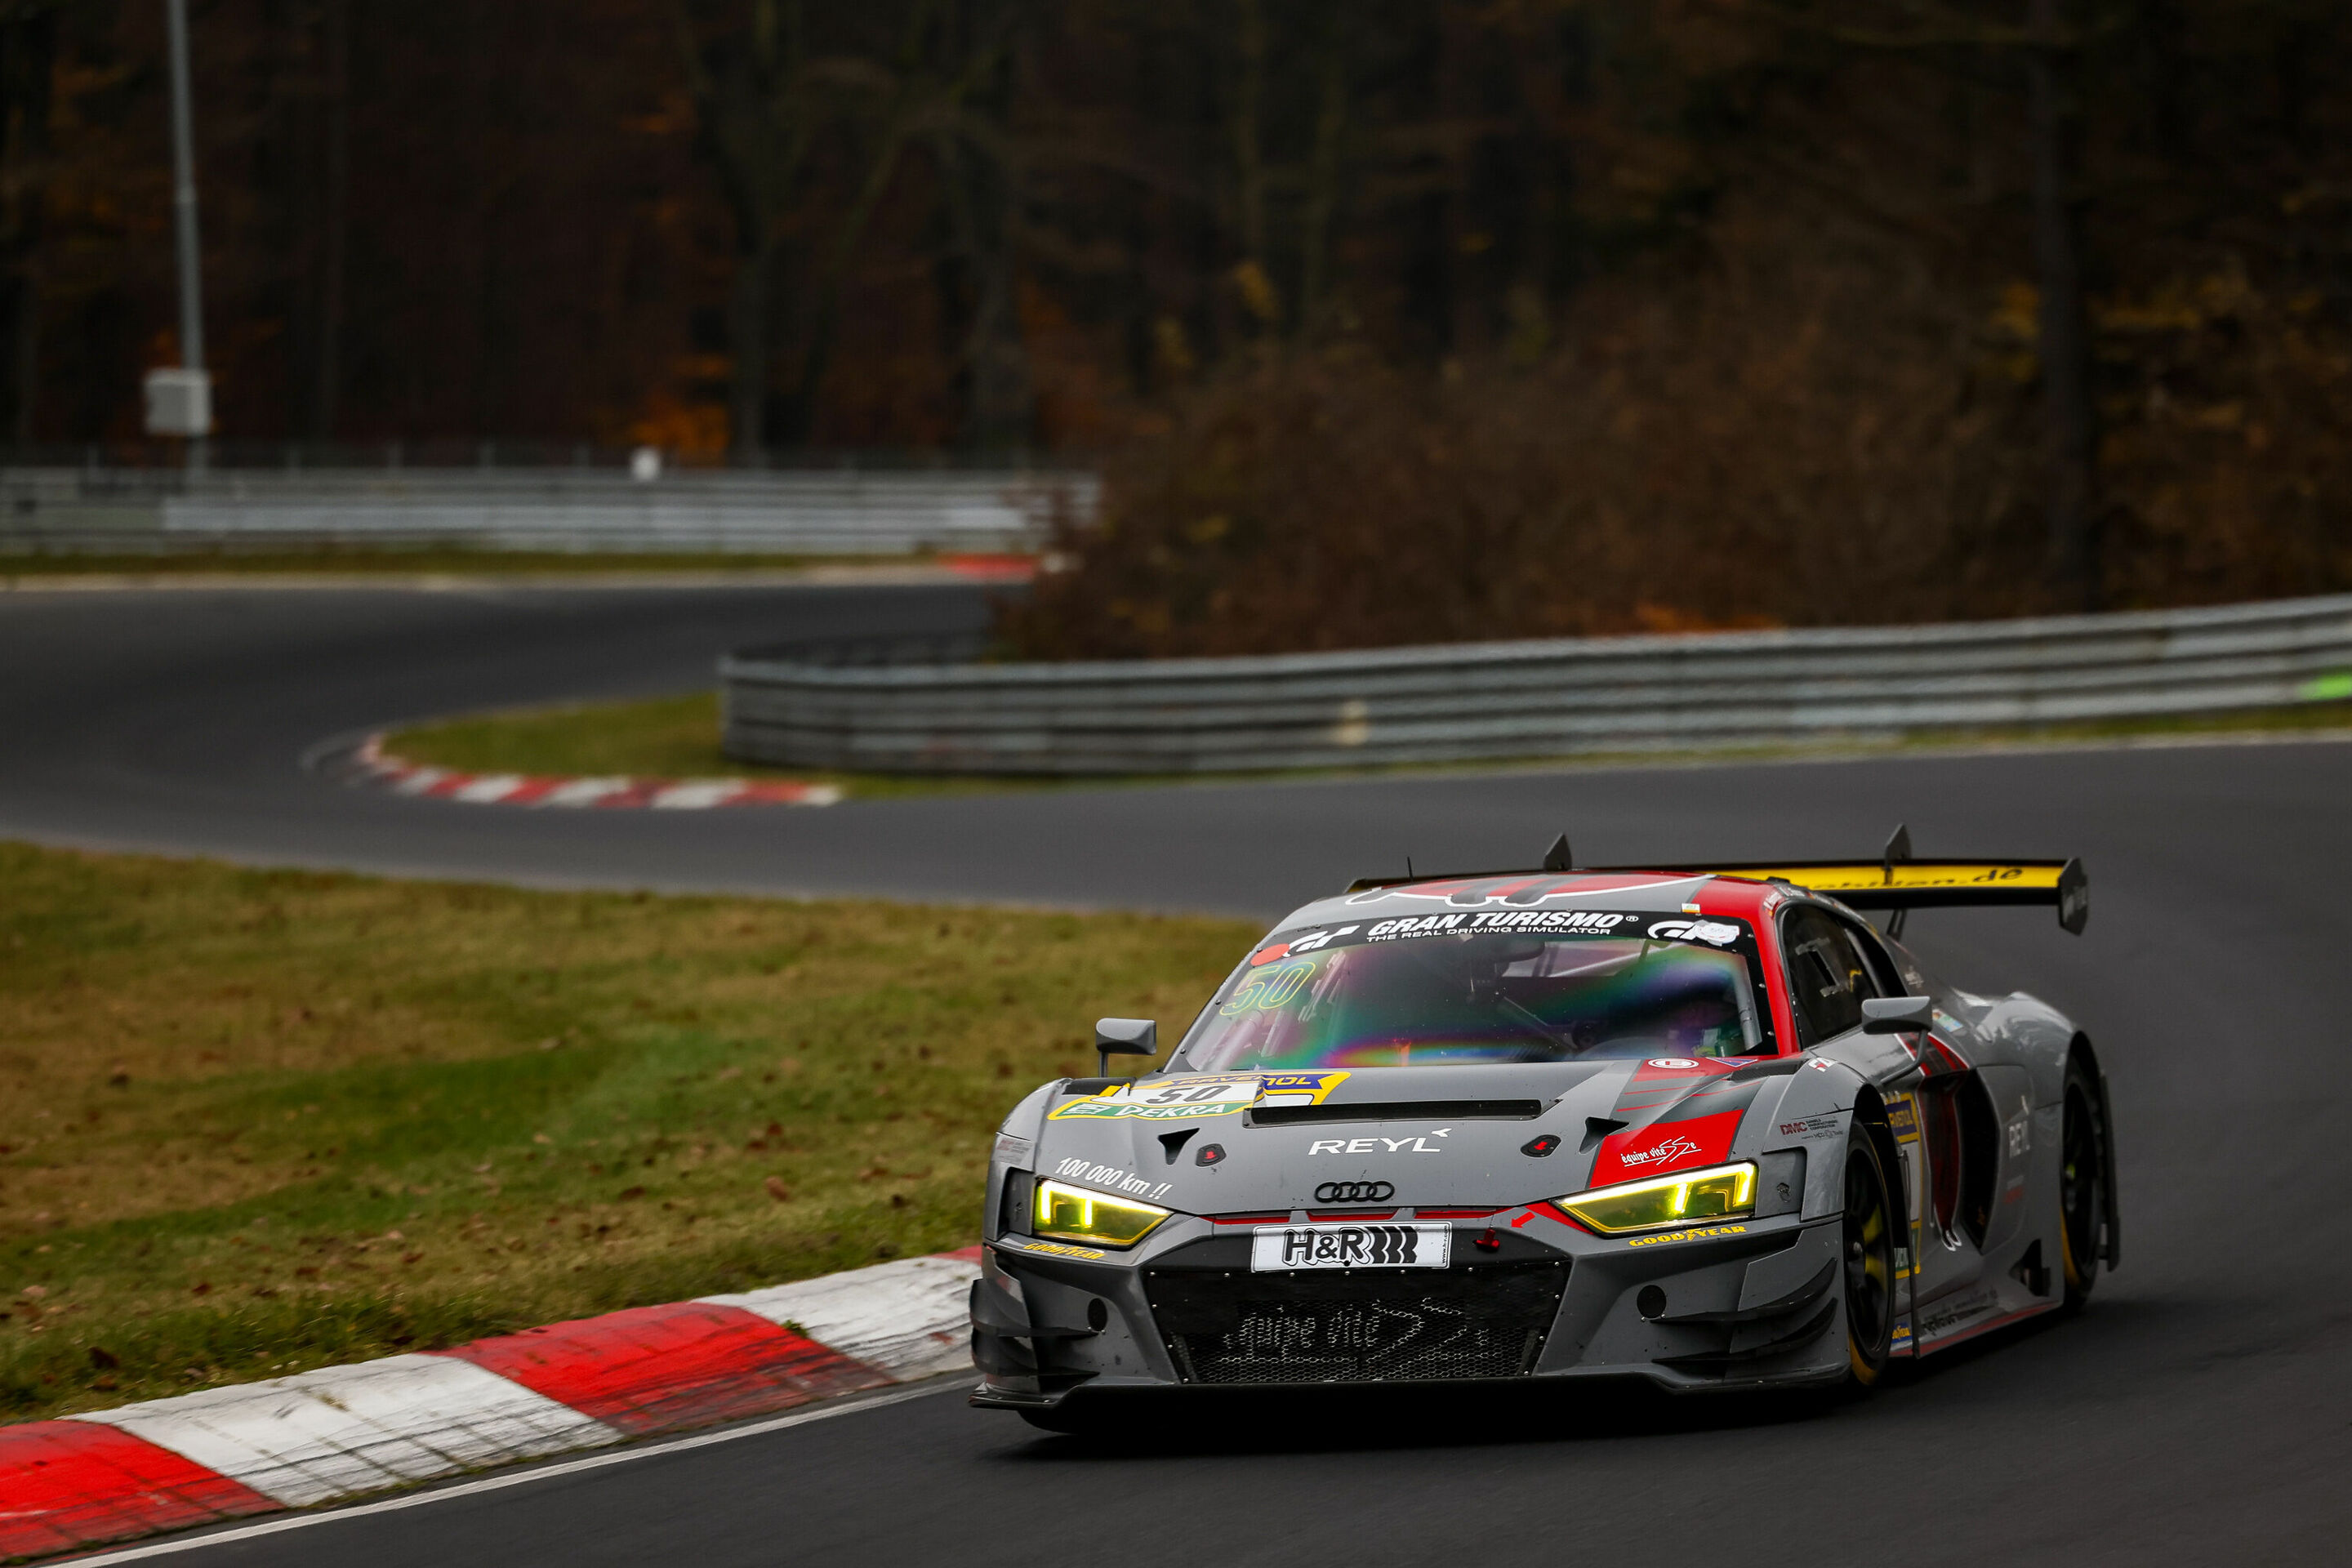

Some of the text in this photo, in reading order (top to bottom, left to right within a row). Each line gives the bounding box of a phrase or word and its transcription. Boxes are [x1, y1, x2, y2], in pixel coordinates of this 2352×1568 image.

[1366, 926, 1610, 942] THE REAL DRIVING SIMULATOR
[1367, 914, 1467, 937] GRAN
[1219, 962, 1316, 1016] 50
[1146, 1085, 1232, 1103] 50
[1115, 1103, 1226, 1118] DEKRA
[1780, 1121, 1808, 1135] DMC
[1307, 1137, 1441, 1156] REYL
[1055, 1156, 1091, 1178] 100
[1085, 1165, 1124, 1186] 000
[1117, 1173, 1151, 1195] km
[1628, 1226, 1747, 1247] GOODYEAR
[1023, 1243, 1105, 1259] GOODYEAR
[1283, 1227, 1371, 1266] H&R
